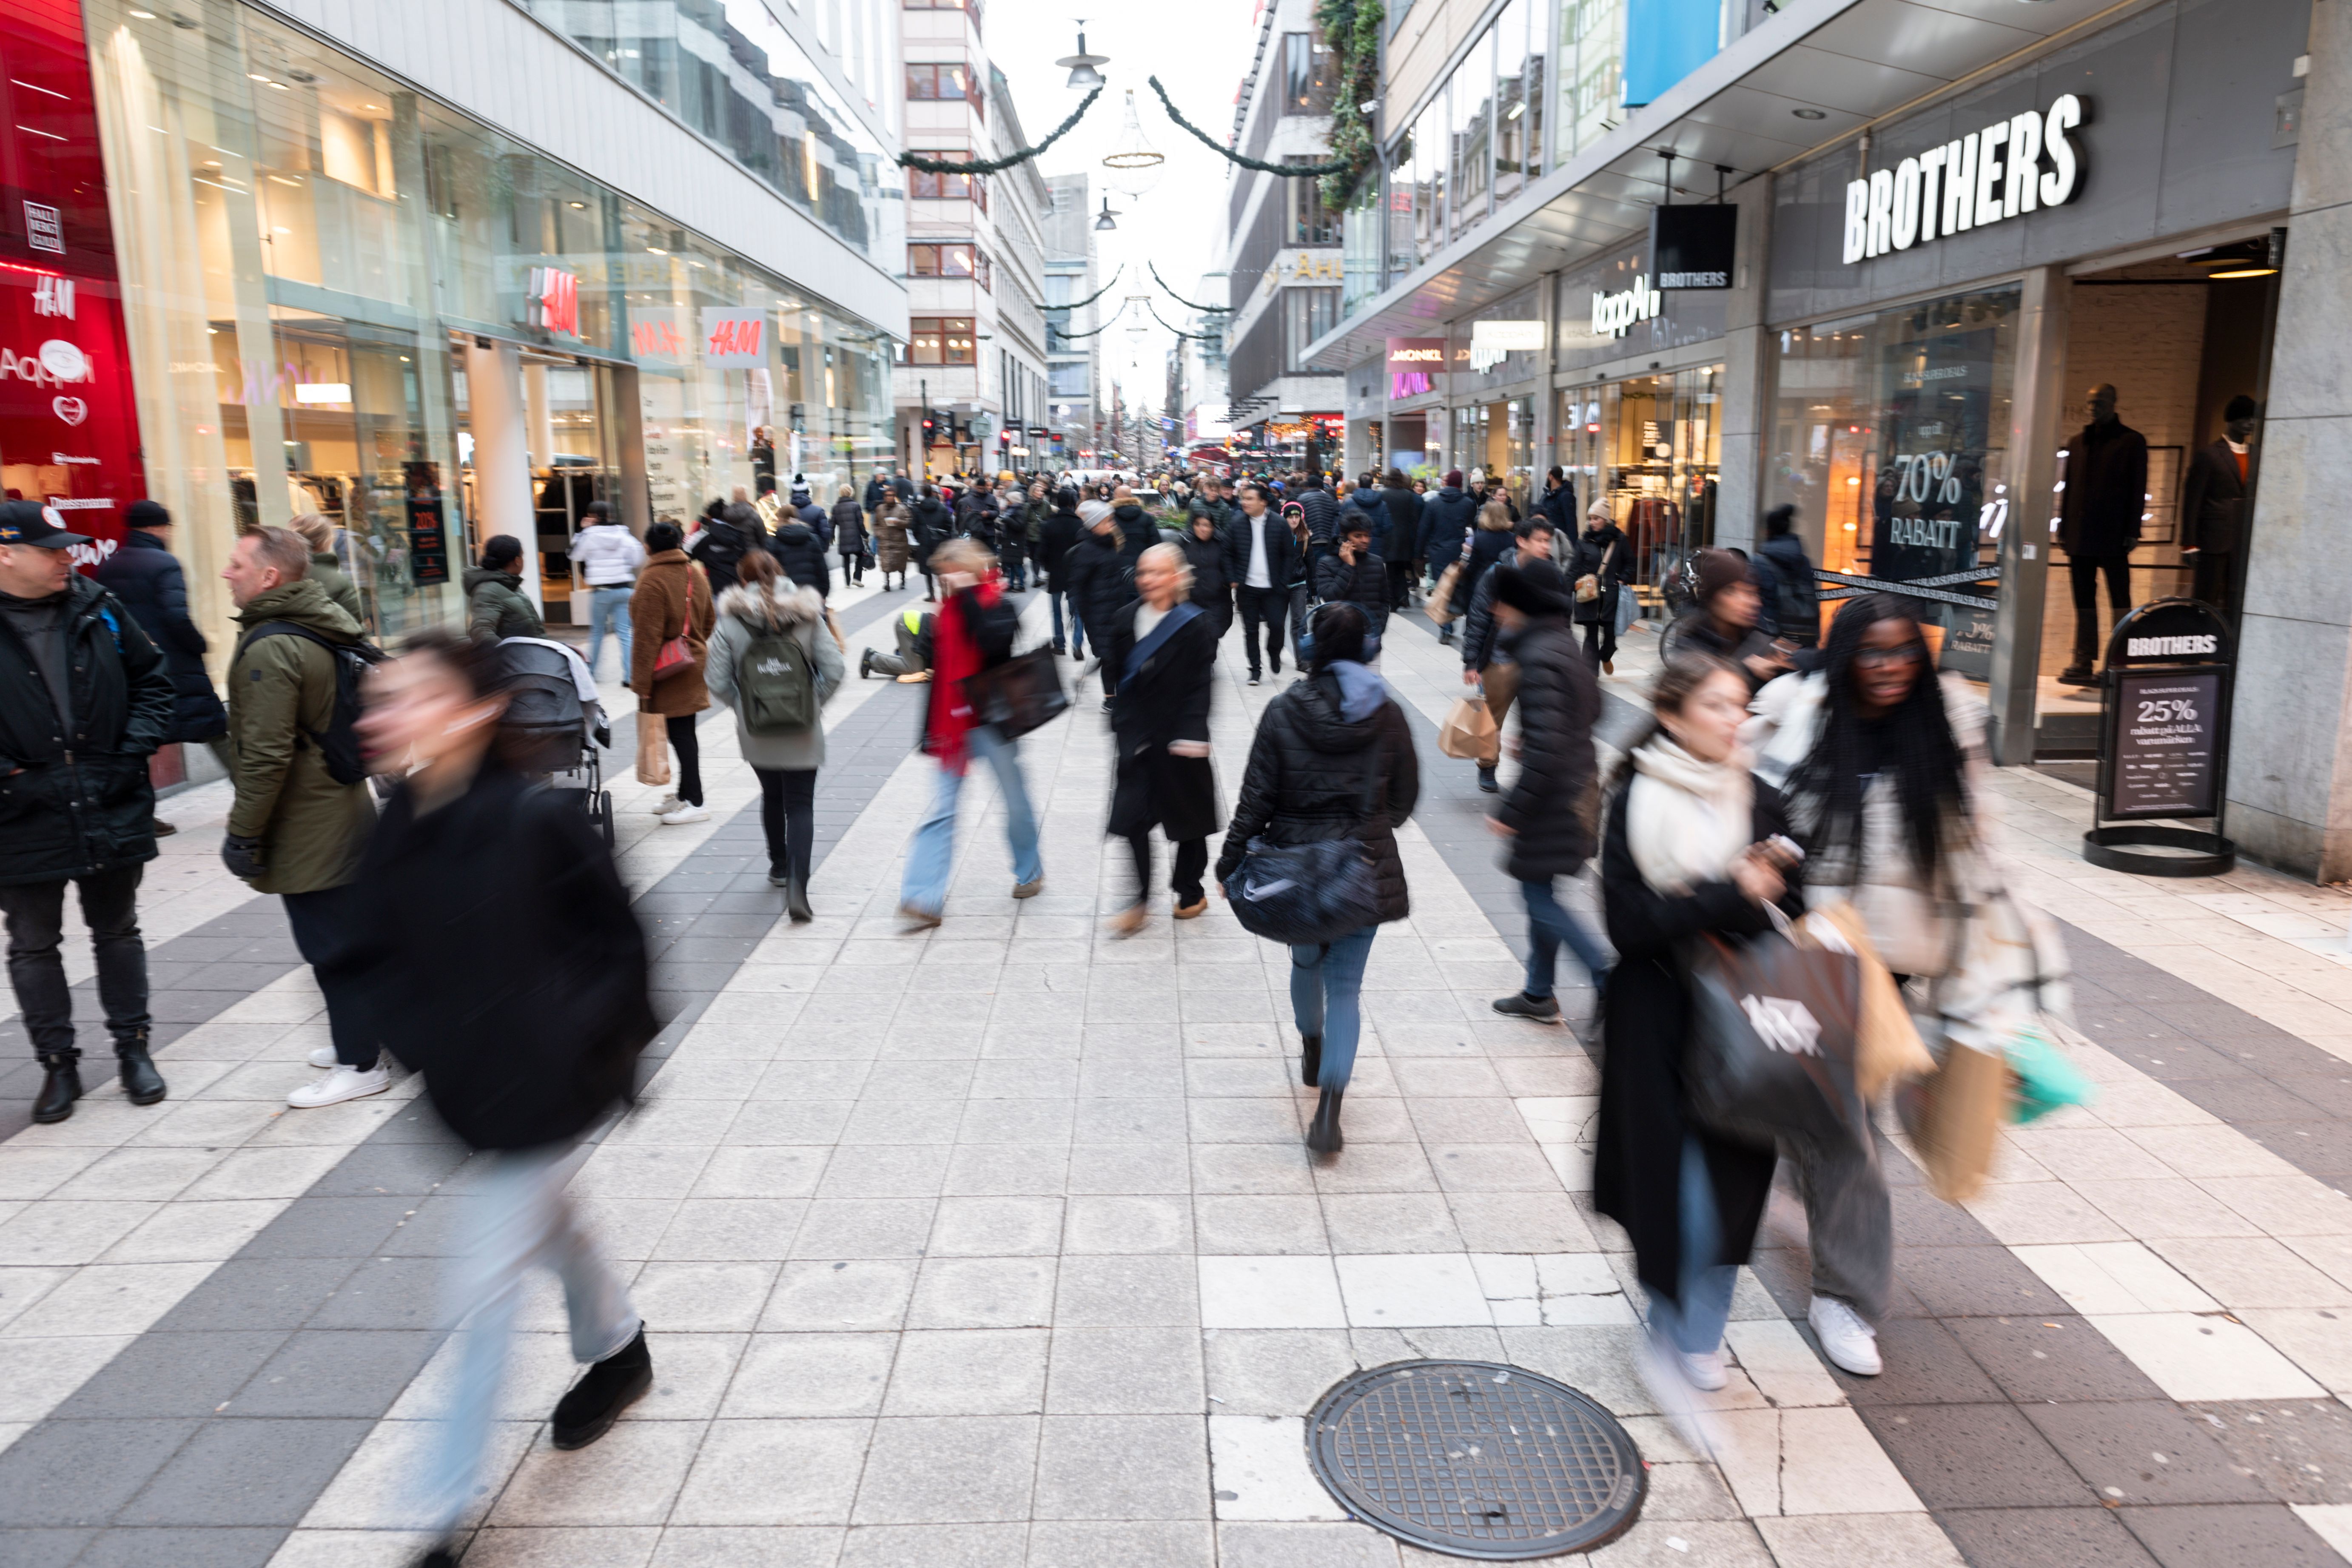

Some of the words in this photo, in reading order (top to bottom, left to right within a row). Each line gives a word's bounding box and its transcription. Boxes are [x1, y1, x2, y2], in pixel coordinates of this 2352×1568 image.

[1843, 94, 2082, 265] BROTHERS
[1660, 272, 1727, 287] BROTHERS
[31, 274, 76, 321] H&M
[709, 320, 761, 356] H&M
[1919, 426, 1931, 438] upp
[1894, 453, 1962, 504] 70%
[1890, 517, 1962, 549] RABATT
[2127, 635, 2217, 657] BROTHERS
[2137, 699, 2198, 722] 25%
[2130, 726, 2159, 735] rabatt
[2175, 724, 2204, 733] ALLA
